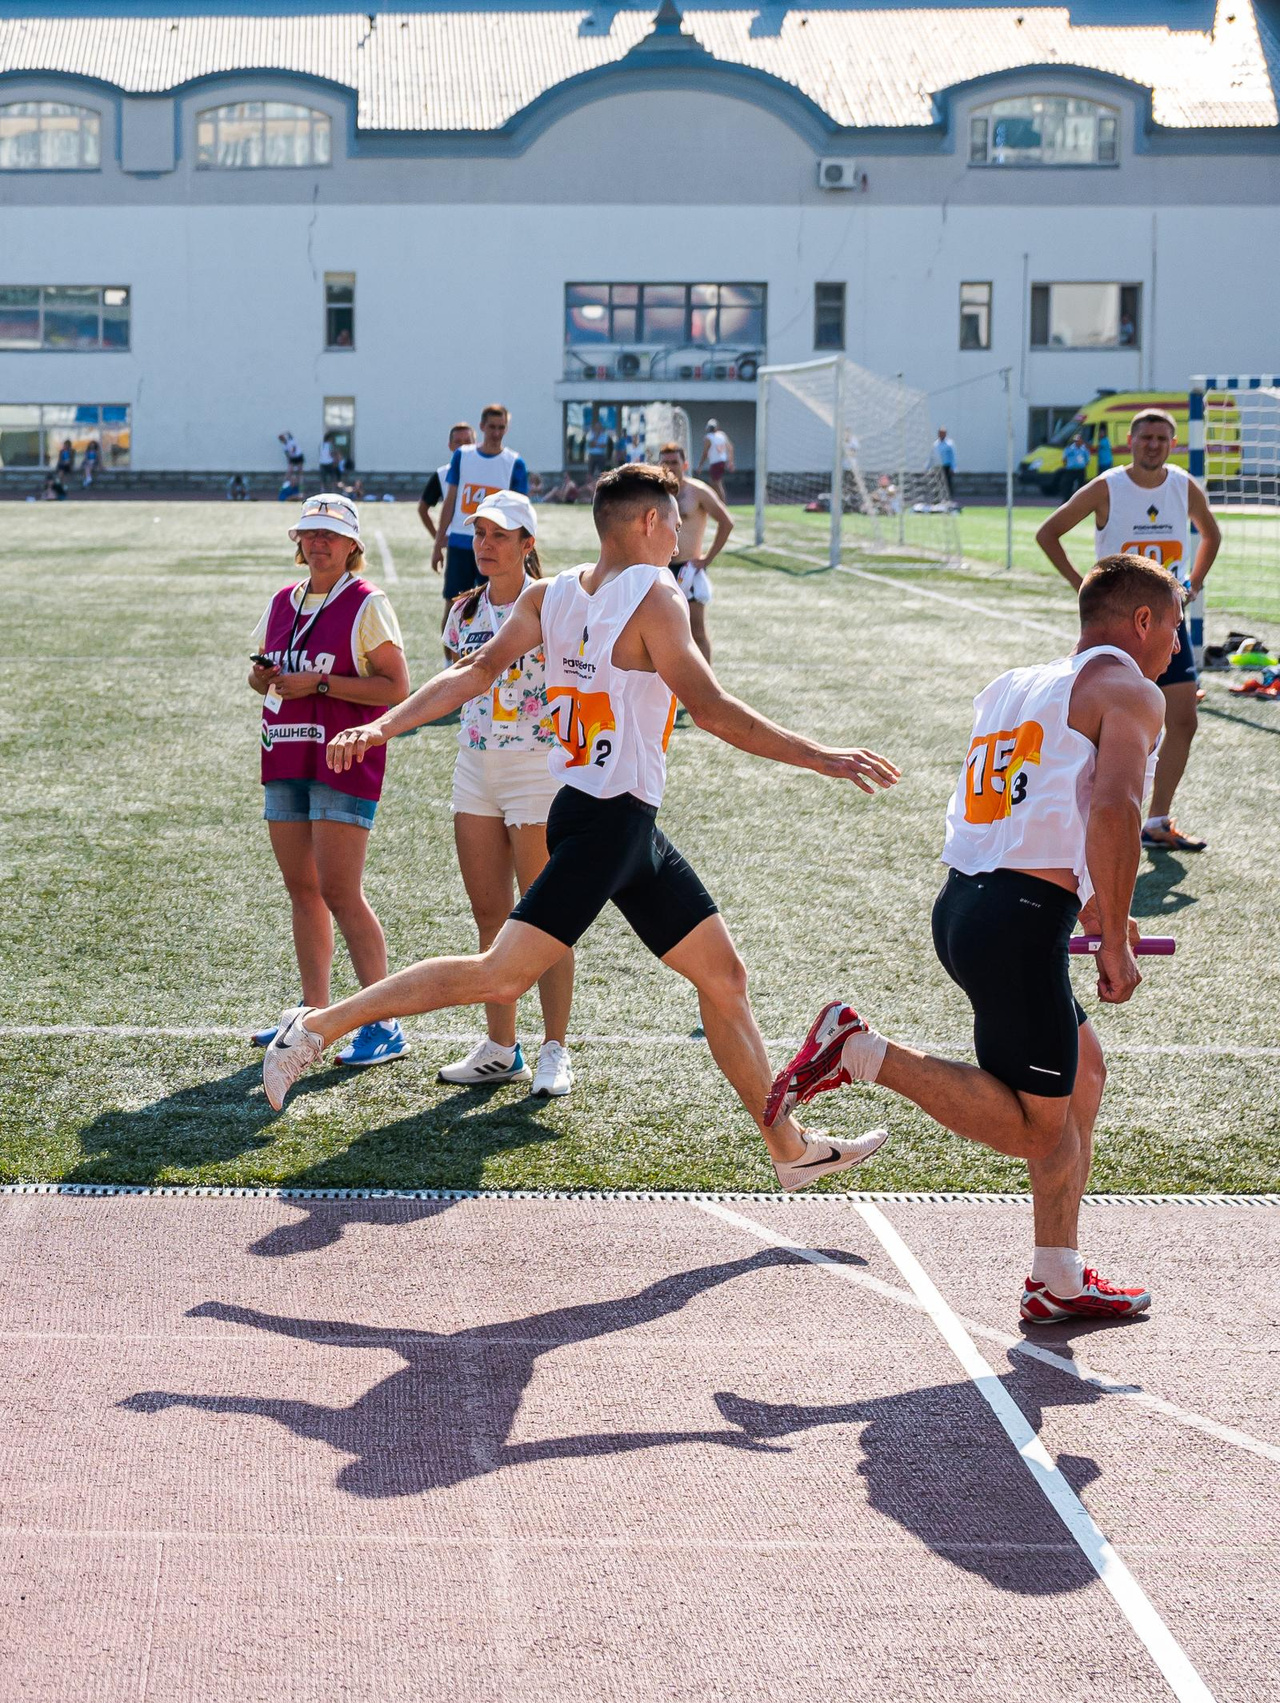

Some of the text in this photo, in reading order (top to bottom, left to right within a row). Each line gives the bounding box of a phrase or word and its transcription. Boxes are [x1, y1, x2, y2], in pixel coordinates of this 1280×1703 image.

[463, 486, 487, 505] 14
[594, 739, 612, 767] 2
[968, 737, 1018, 796] 15
[1011, 771, 1028, 806] 3
